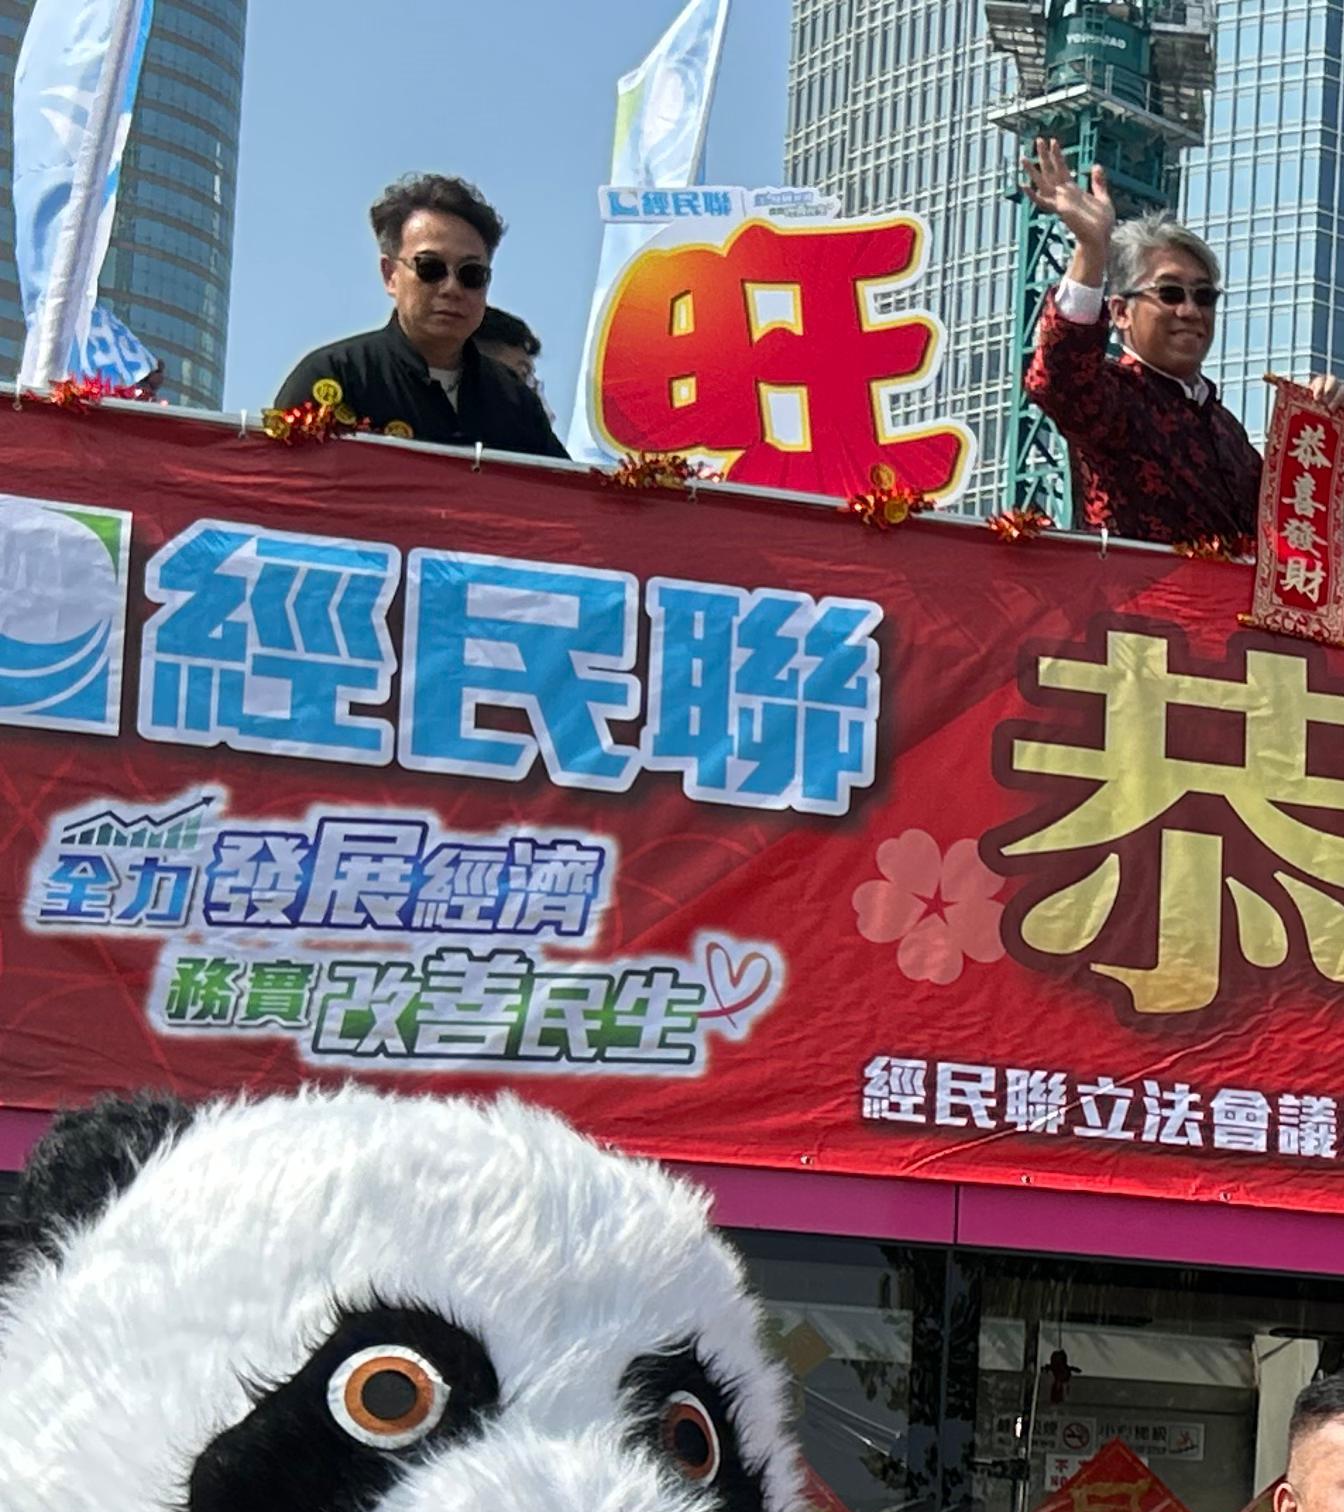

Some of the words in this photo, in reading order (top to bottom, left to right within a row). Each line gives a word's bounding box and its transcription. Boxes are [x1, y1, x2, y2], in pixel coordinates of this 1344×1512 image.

[641, 191, 731, 216] 經民聯
[601, 220, 961, 494] 旺
[1280, 424, 1332, 604] 恭喜發財
[142, 520, 882, 811] 經民聯
[37, 818, 606, 936] 全力發展經濟
[166, 948, 707, 1064] 務實改善民生
